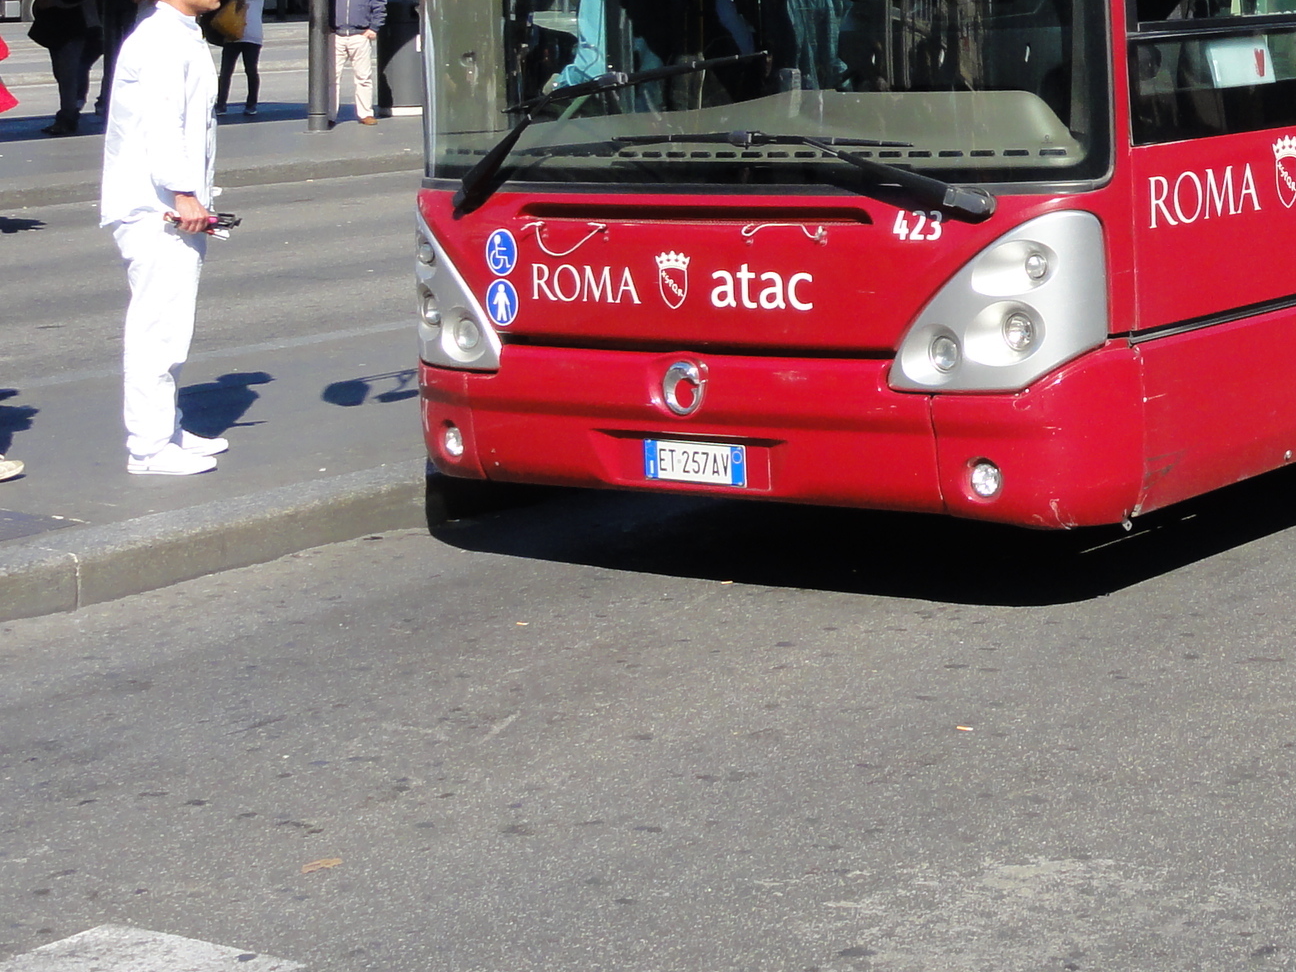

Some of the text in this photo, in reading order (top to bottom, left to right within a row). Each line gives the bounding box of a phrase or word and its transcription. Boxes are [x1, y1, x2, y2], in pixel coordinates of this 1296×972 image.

[1148, 163, 1261, 229] ROMA
[893, 210, 942, 241] 423
[532, 264, 642, 305] ROMA
[711, 264, 813, 311] atac
[659, 448, 729, 477] ET 257AV
